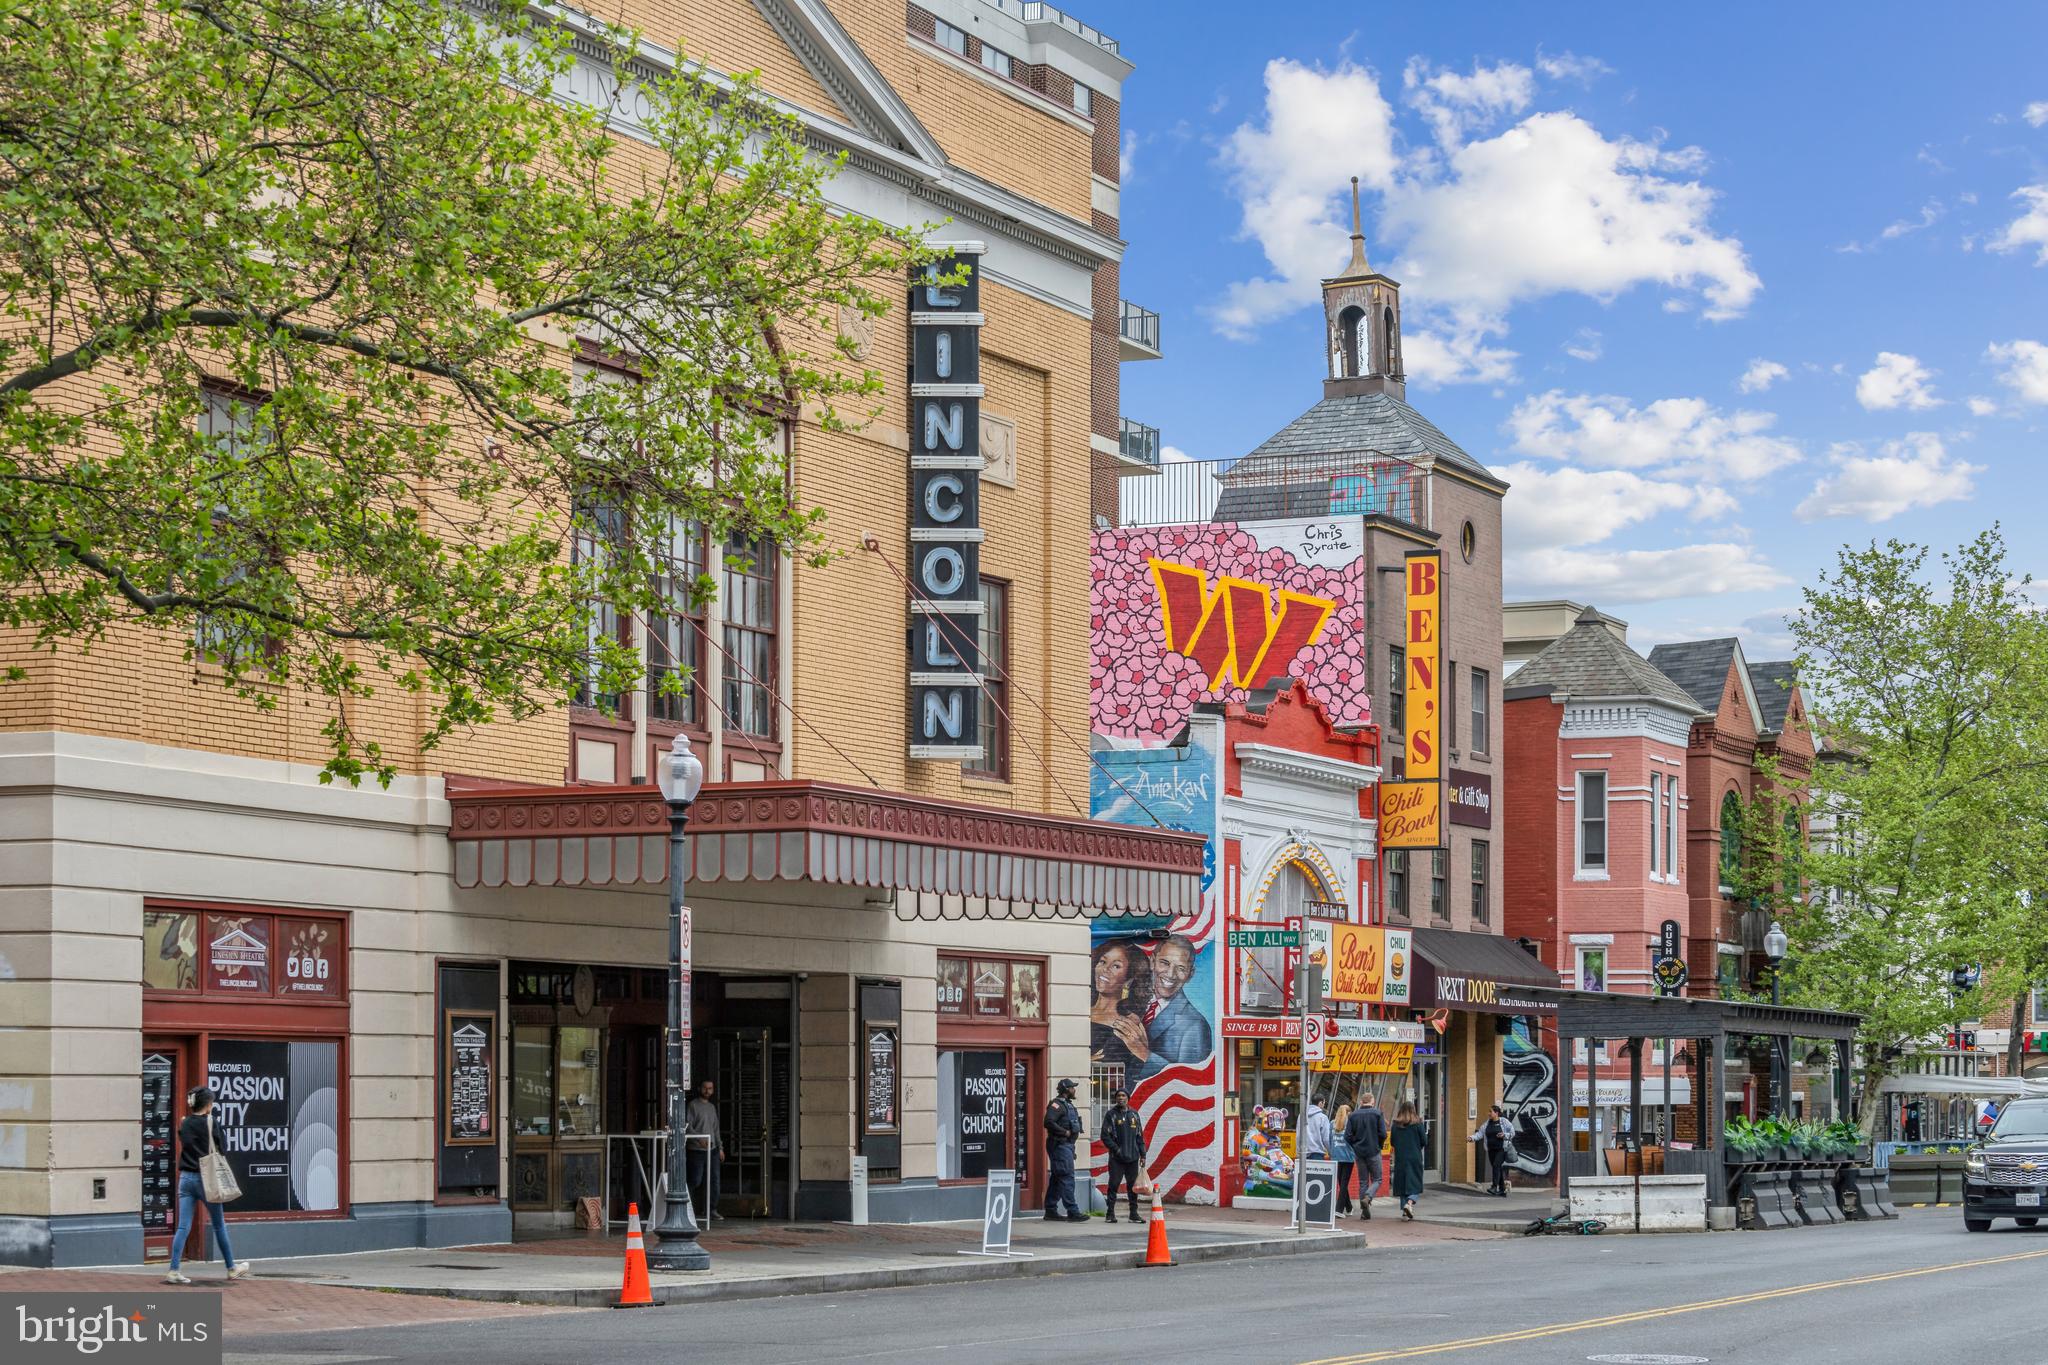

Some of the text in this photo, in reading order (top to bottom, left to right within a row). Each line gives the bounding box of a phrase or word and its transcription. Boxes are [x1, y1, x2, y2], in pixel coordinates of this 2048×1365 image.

[923, 254, 966, 738] LINCOLN
[1305, 524, 1343, 540] Chris
[1300, 541, 1351, 558] Pyrate
[1409, 562, 1436, 765] BEN'S
[1382, 787, 1424, 816] Chili
[1476, 788, 1490, 814] Shop
[1382, 815, 1437, 842] Bowl
[1229, 932, 1256, 946] BEN
[1263, 932, 1283, 946] ALI
[1309, 929, 1327, 943] CHILI
[1390, 937, 1406, 950] CHILI
[1665, 924, 1673, 955] RUSH
[212, 950, 265, 961] LINCOLN THEATRE
[1339, 932, 1375, 972] Ben's
[1336, 971, 1355, 993] Chili
[1355, 973, 1381, 995] Bowl
[1385, 983, 1407, 996] BURGER
[1225, 1023, 1278, 1033] SINCE 1958
[1267, 1056, 1301, 1067] SHAKE
[1366, 1041, 1399, 1066] Bowl
[208, 1063, 251, 1073] WELCOME TO
[208, 1076, 284, 1100] PASSION
[965, 1078, 1007, 1096] PASSION
[212, 1102, 250, 1126] CITY
[985, 1097, 1007, 1115] CITY
[962, 1116, 1005, 1135] CHURCH
[226, 1127, 288, 1151] HURCH
